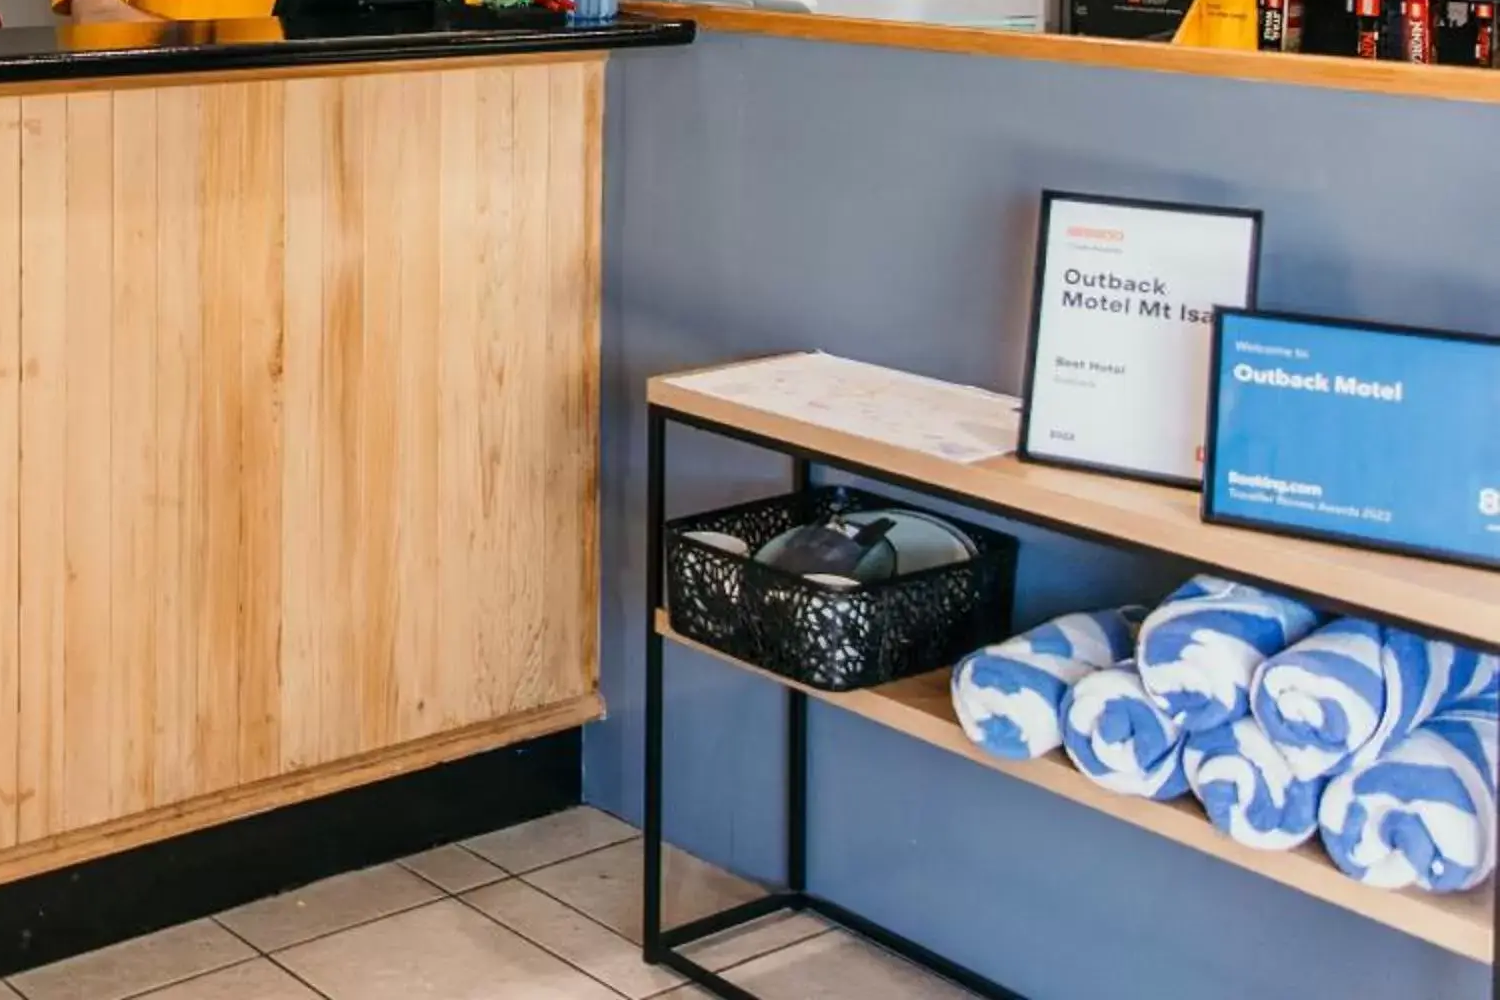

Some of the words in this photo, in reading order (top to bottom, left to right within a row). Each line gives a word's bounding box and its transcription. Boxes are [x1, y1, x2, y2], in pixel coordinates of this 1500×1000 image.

[1064, 268, 1167, 296] Outback
[1062, 290, 1130, 316] Motel
[1138, 300, 1172, 320] Mt
[1180, 304, 1214, 323] Isa
[1055, 355, 1086, 369] Best
[1235, 340, 1293, 358] Welcome
[1233, 363, 1330, 393] Outback
[1334, 375, 1404, 402] Motel
[1227, 470, 1323, 497] Booking.com
[1317, 501, 1360, 517] Awards
